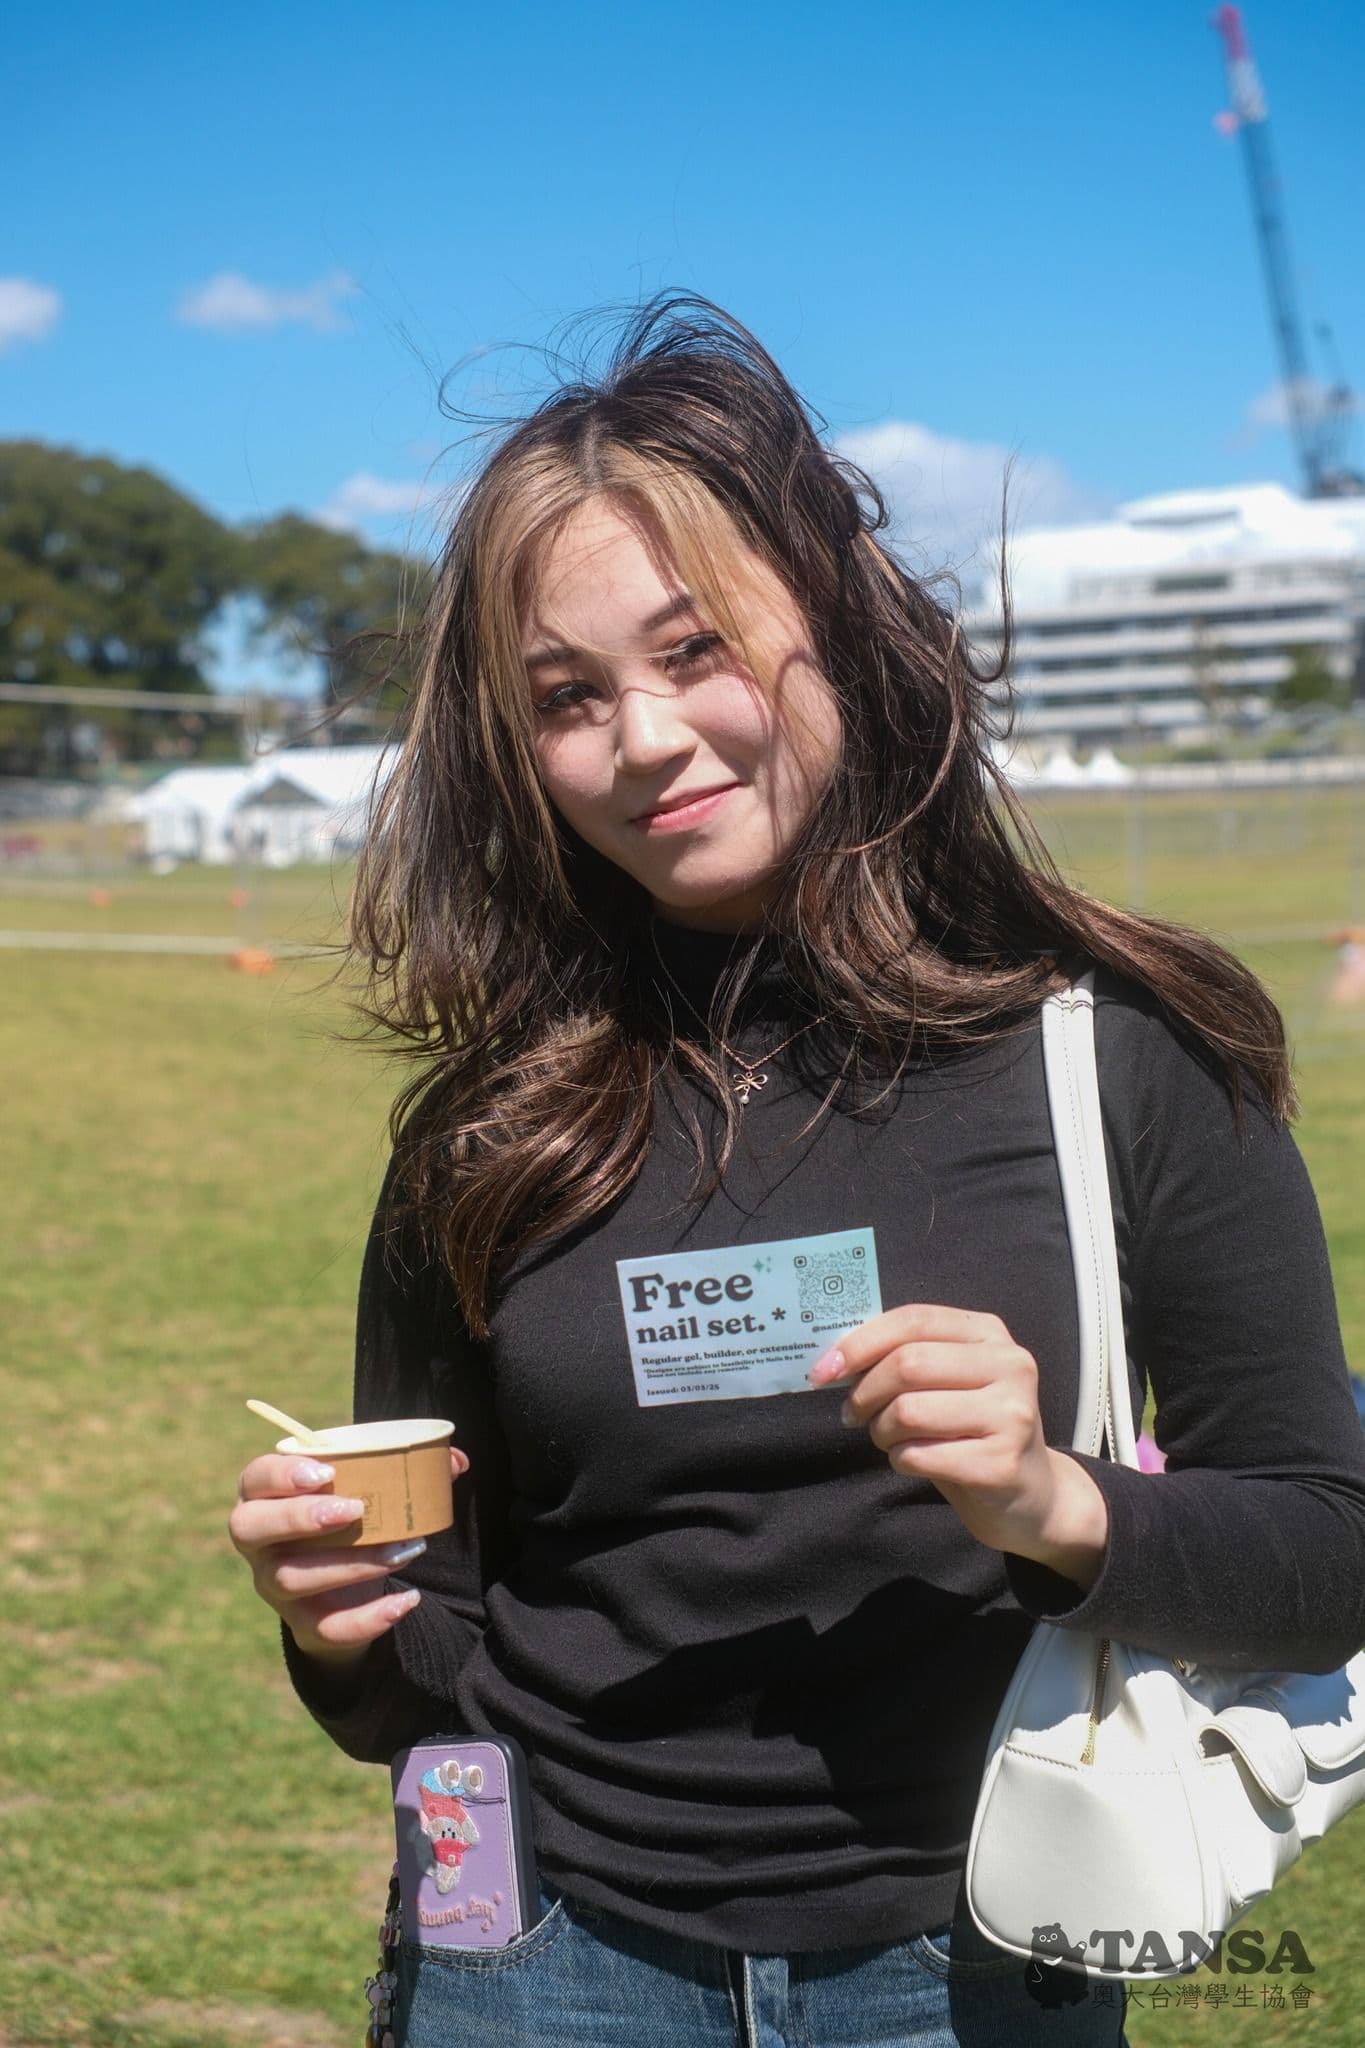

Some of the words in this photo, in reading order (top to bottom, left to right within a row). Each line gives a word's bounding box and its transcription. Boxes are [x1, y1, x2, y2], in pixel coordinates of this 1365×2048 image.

[628, 1272, 753, 1312] Free
[636, 1316, 700, 1344] nail
[641, 1355, 682, 1365] Regular
[703, 1349, 744, 1360] builder,
[759, 1341, 819, 1354] extensions.
[646, 1387, 679, 1396] Issued:
